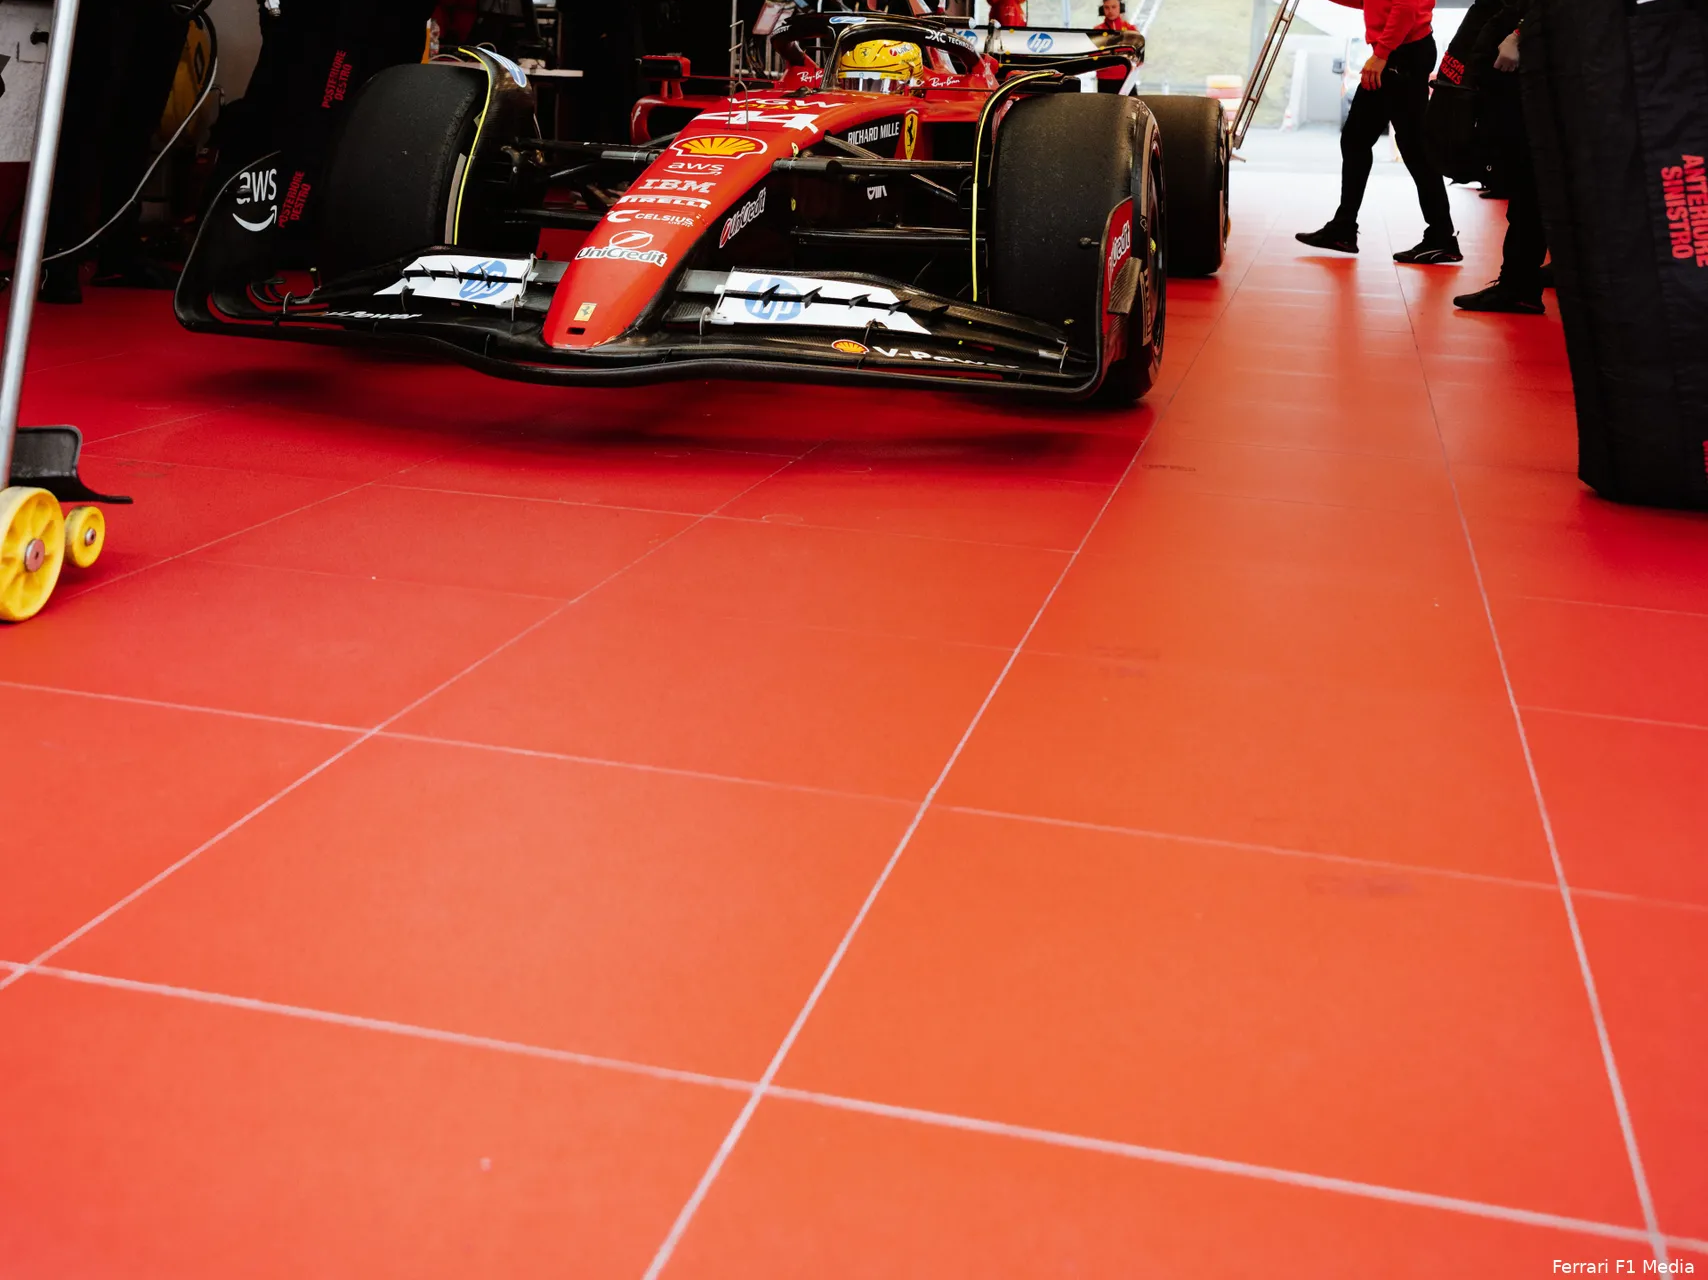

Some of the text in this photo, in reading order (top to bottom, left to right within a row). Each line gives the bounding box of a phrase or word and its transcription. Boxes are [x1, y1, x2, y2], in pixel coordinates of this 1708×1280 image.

[1028, 32, 1052, 54] hp
[334, 63, 353, 100] DESTRO
[928, 75, 960, 87] Ray-Ban
[848, 121, 900, 146] RICHARD MILLE
[665, 161, 725, 173] aws
[236, 168, 278, 205] aws
[638, 178, 717, 194] IBM
[289, 183, 311, 221] DESTRO
[616, 194, 712, 209] PIRELLI
[1661, 166, 1695, 259] SINISTRO
[1681, 154, 1708, 267] ANTERIORE
[634, 213, 694, 226] CELSIUS
[575, 245, 668, 267] UniCredit
